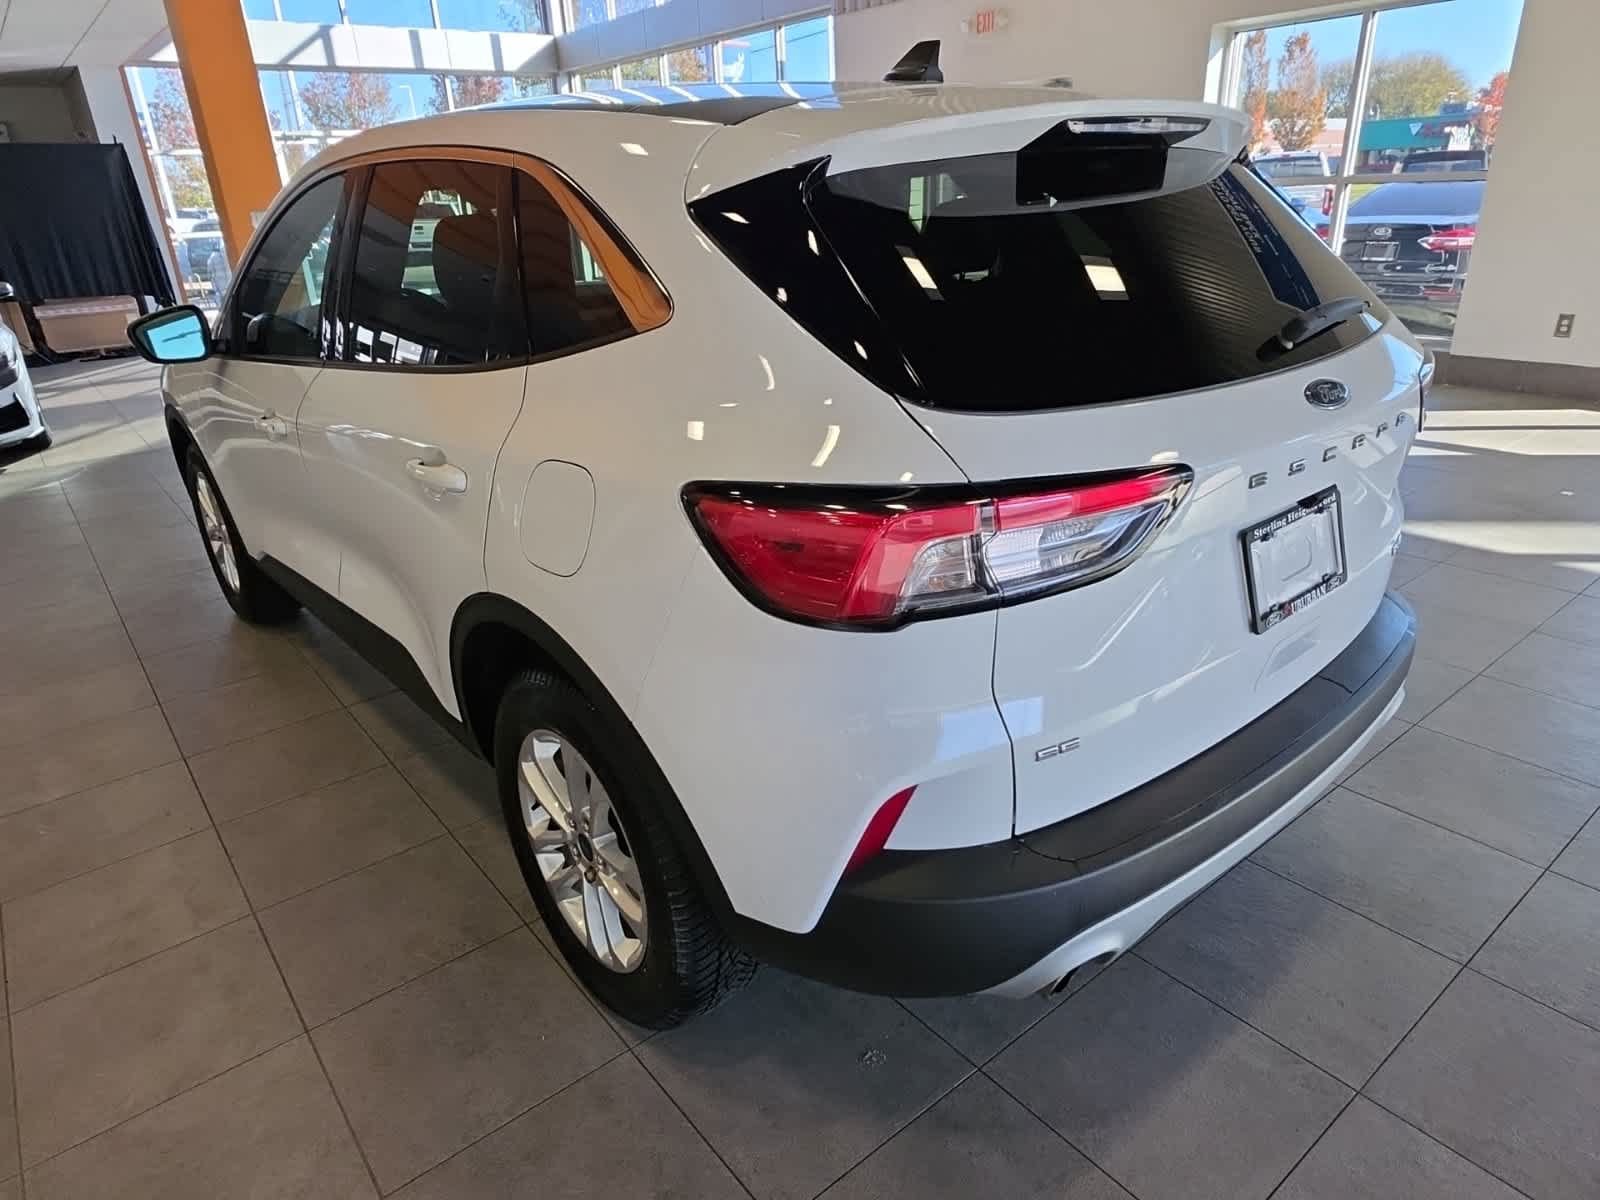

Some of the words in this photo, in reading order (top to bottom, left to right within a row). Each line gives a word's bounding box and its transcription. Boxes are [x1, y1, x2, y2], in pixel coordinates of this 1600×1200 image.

[976, 10, 996, 33] EXIT
[1316, 383, 1345, 403] Ford
[1248, 412, 1407, 490] ESCAPE
[1253, 517, 1287, 539] Sterling
